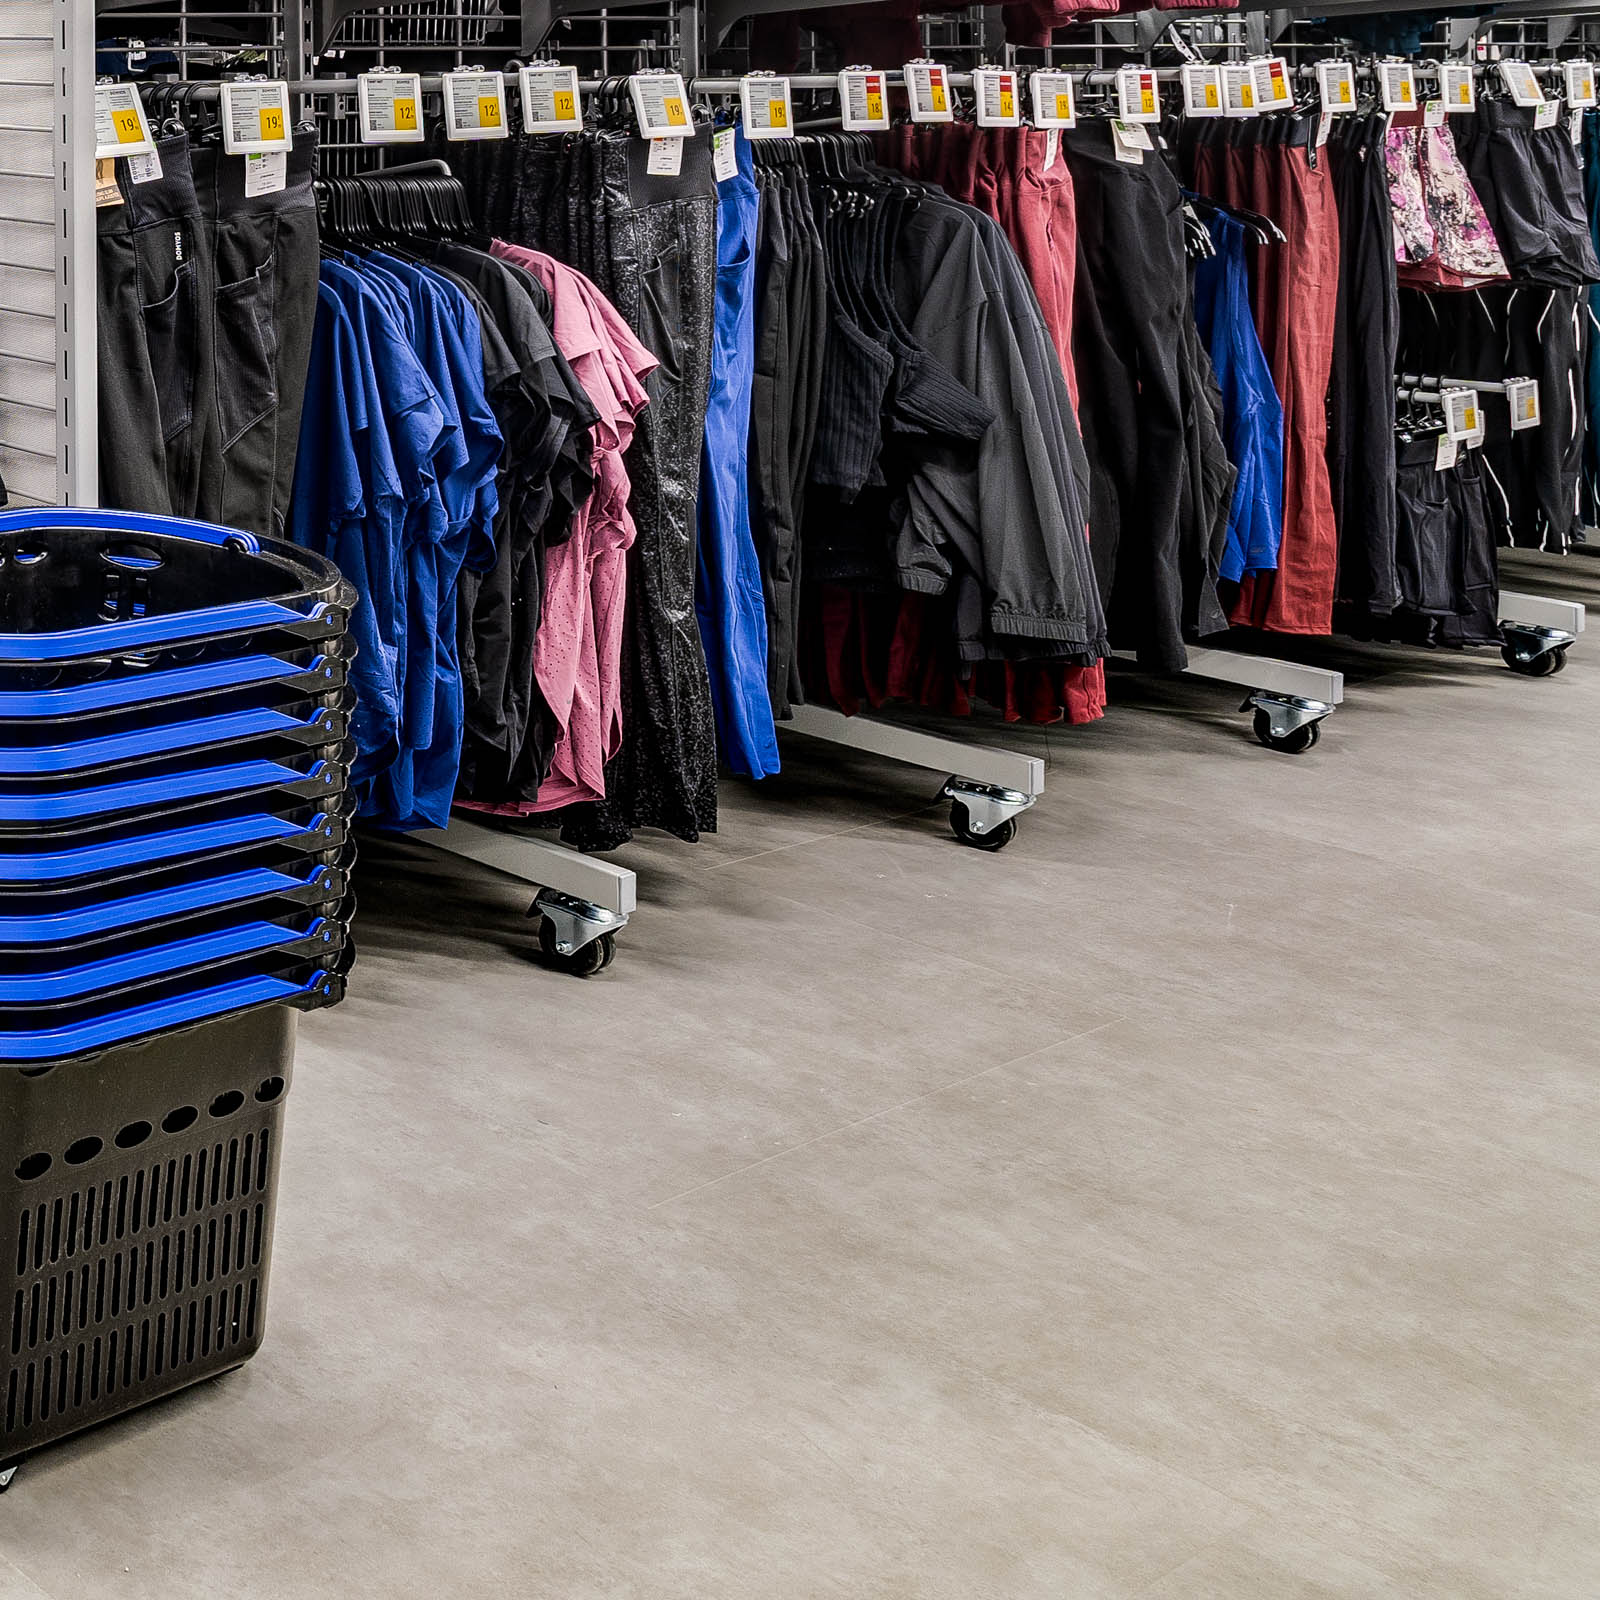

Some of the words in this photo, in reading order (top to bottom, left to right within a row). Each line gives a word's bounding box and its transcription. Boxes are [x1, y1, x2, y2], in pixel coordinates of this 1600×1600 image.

[484, 104, 495, 116] 12
[559, 98, 570, 110] 12
[670, 105, 681, 115] 19
[400, 106, 411, 119] 12
[774, 107, 783, 118] 19
[120, 118, 134, 131] 19
[266, 116, 278, 129] 19
[175, 231, 183, 261] DOMYOS
